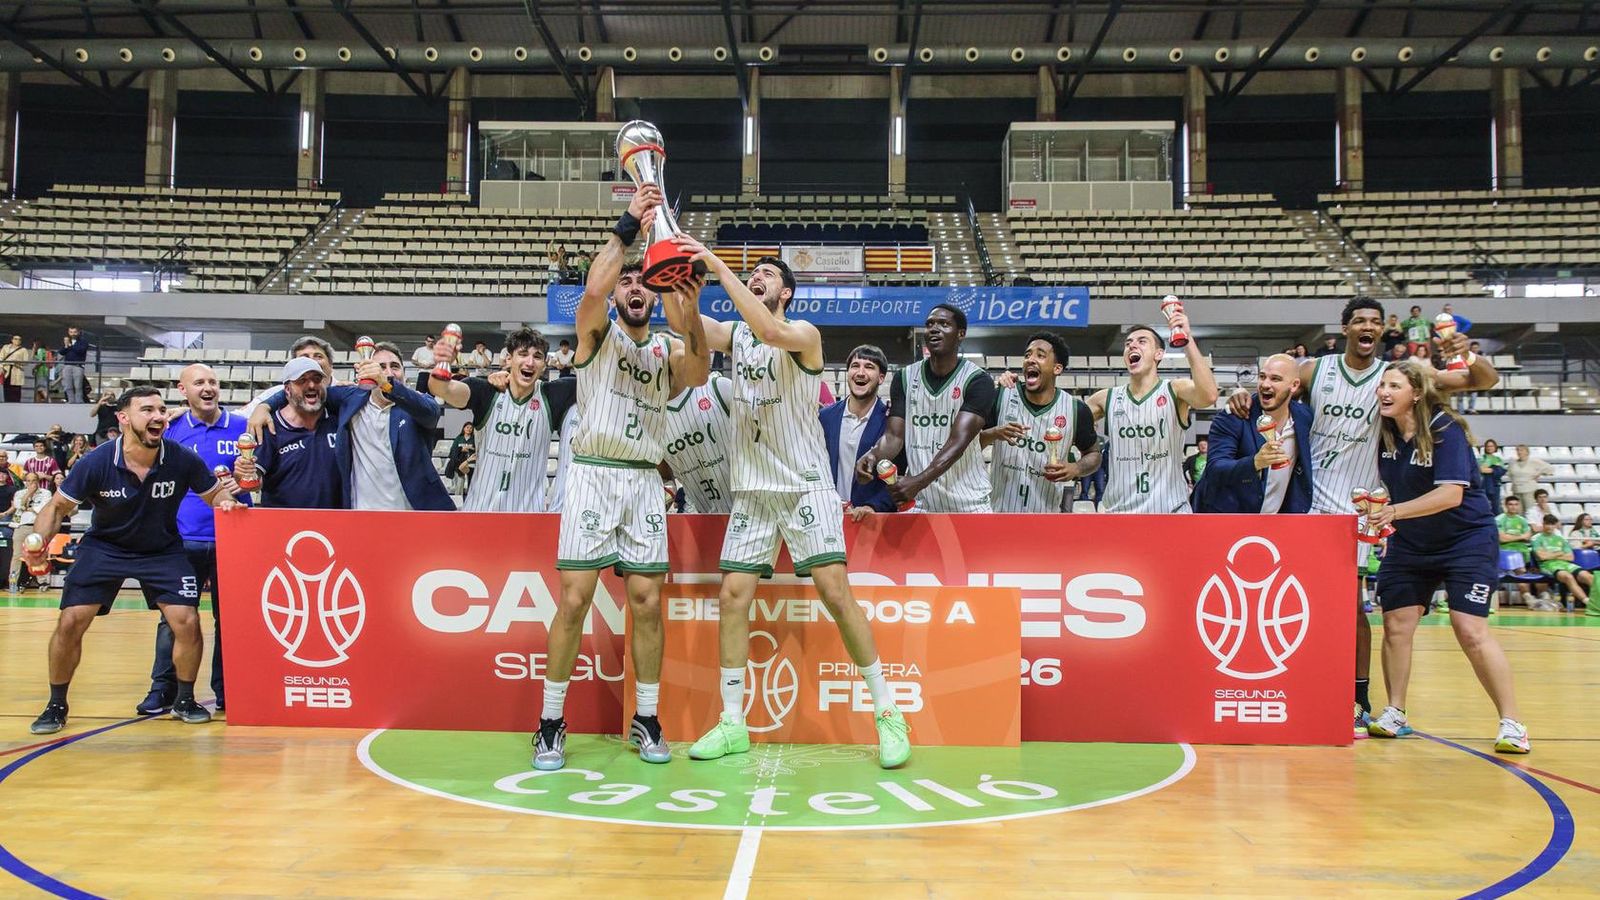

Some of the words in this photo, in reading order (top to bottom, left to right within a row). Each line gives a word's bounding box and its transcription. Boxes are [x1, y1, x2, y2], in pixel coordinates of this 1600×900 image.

[826, 300, 842, 313] EL
[849, 300, 922, 314] DEPORTE
[978, 293, 1080, 321] ibertic
[911, 412, 949, 427] coto
[1323, 403, 1365, 419] coto
[1119, 424, 1156, 438] coto
[667, 431, 705, 455] coto
[151, 480, 176, 499] CCB
[1136, 472, 1149, 494] 16
[1019, 484, 1030, 507] 4
[945, 600, 975, 624] A
[284, 675, 350, 686] SEGUNDA
[285, 686, 353, 708] FEB
[819, 680, 924, 712] FEB
[1214, 689, 1287, 699] SEGUNDA
[1214, 701, 1288, 723] FEB
[493, 768, 1059, 816] Castelló
